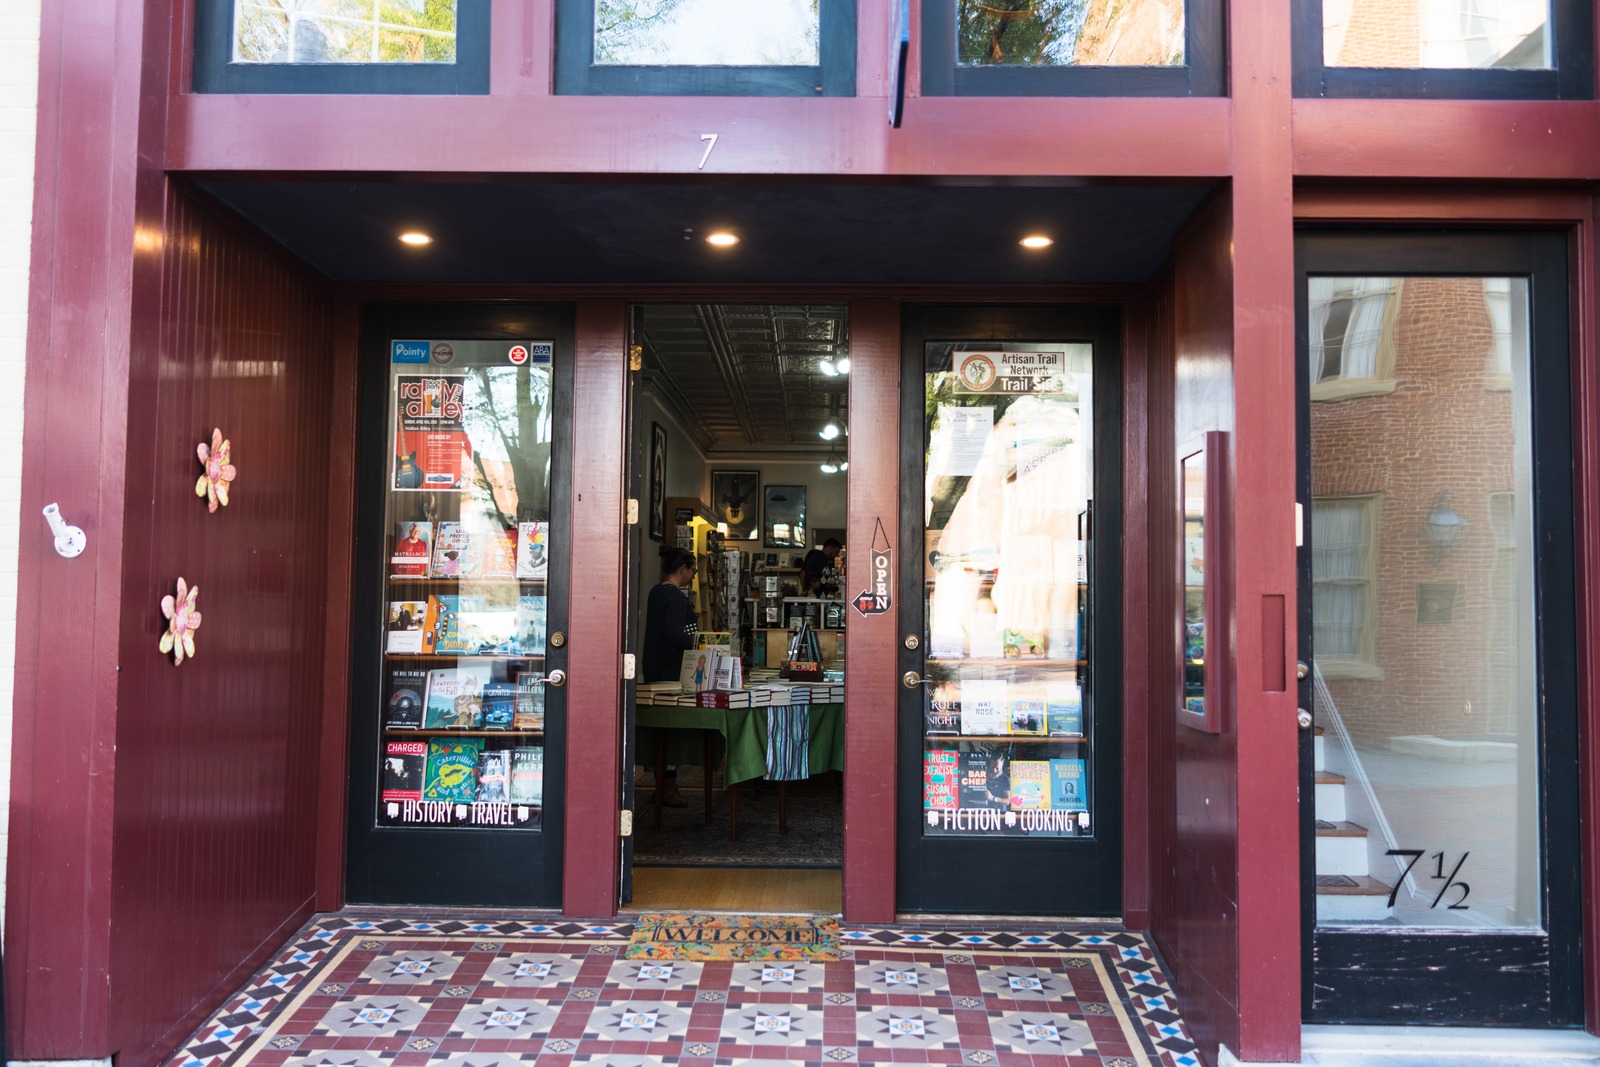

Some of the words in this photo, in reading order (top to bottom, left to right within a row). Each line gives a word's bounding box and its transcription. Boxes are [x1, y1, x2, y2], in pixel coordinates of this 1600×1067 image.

[699, 133, 720, 170] 7
[396, 344, 426, 358] Pointy
[1001, 353, 1035, 365] Artisan
[1037, 354, 1057, 365] Trail
[1010, 365, 1048, 375] Network
[1000, 377, 1028, 391] Trail
[875, 556, 888, 610] OPEN
[445, 687, 458, 695] Fall
[931, 701, 958, 712] RULE
[927, 715, 958, 726] NIGHT
[387, 743, 423, 752] CHARGED
[436, 755, 475, 766] Caterpillar
[928, 754, 950, 763] TRUST
[517, 763, 543, 771] KERR
[924, 765, 954, 775] EXERCISE
[1054, 764, 1083, 772] RUSSELL
[968, 770, 987, 778] BAR
[1058, 771, 1080, 779] BRAND
[961, 777, 987, 786] CHEF
[436, 785, 450, 795] and
[451, 782, 468, 795] Bean
[926, 784, 950, 795] SUSAN
[403, 799, 454, 823] HISTORY
[470, 801, 514, 825] TRAVEL
[943, 807, 1001, 831] FICTION
[1020, 808, 1073, 832] COOKING
[664, 927, 812, 942] WELCOME
